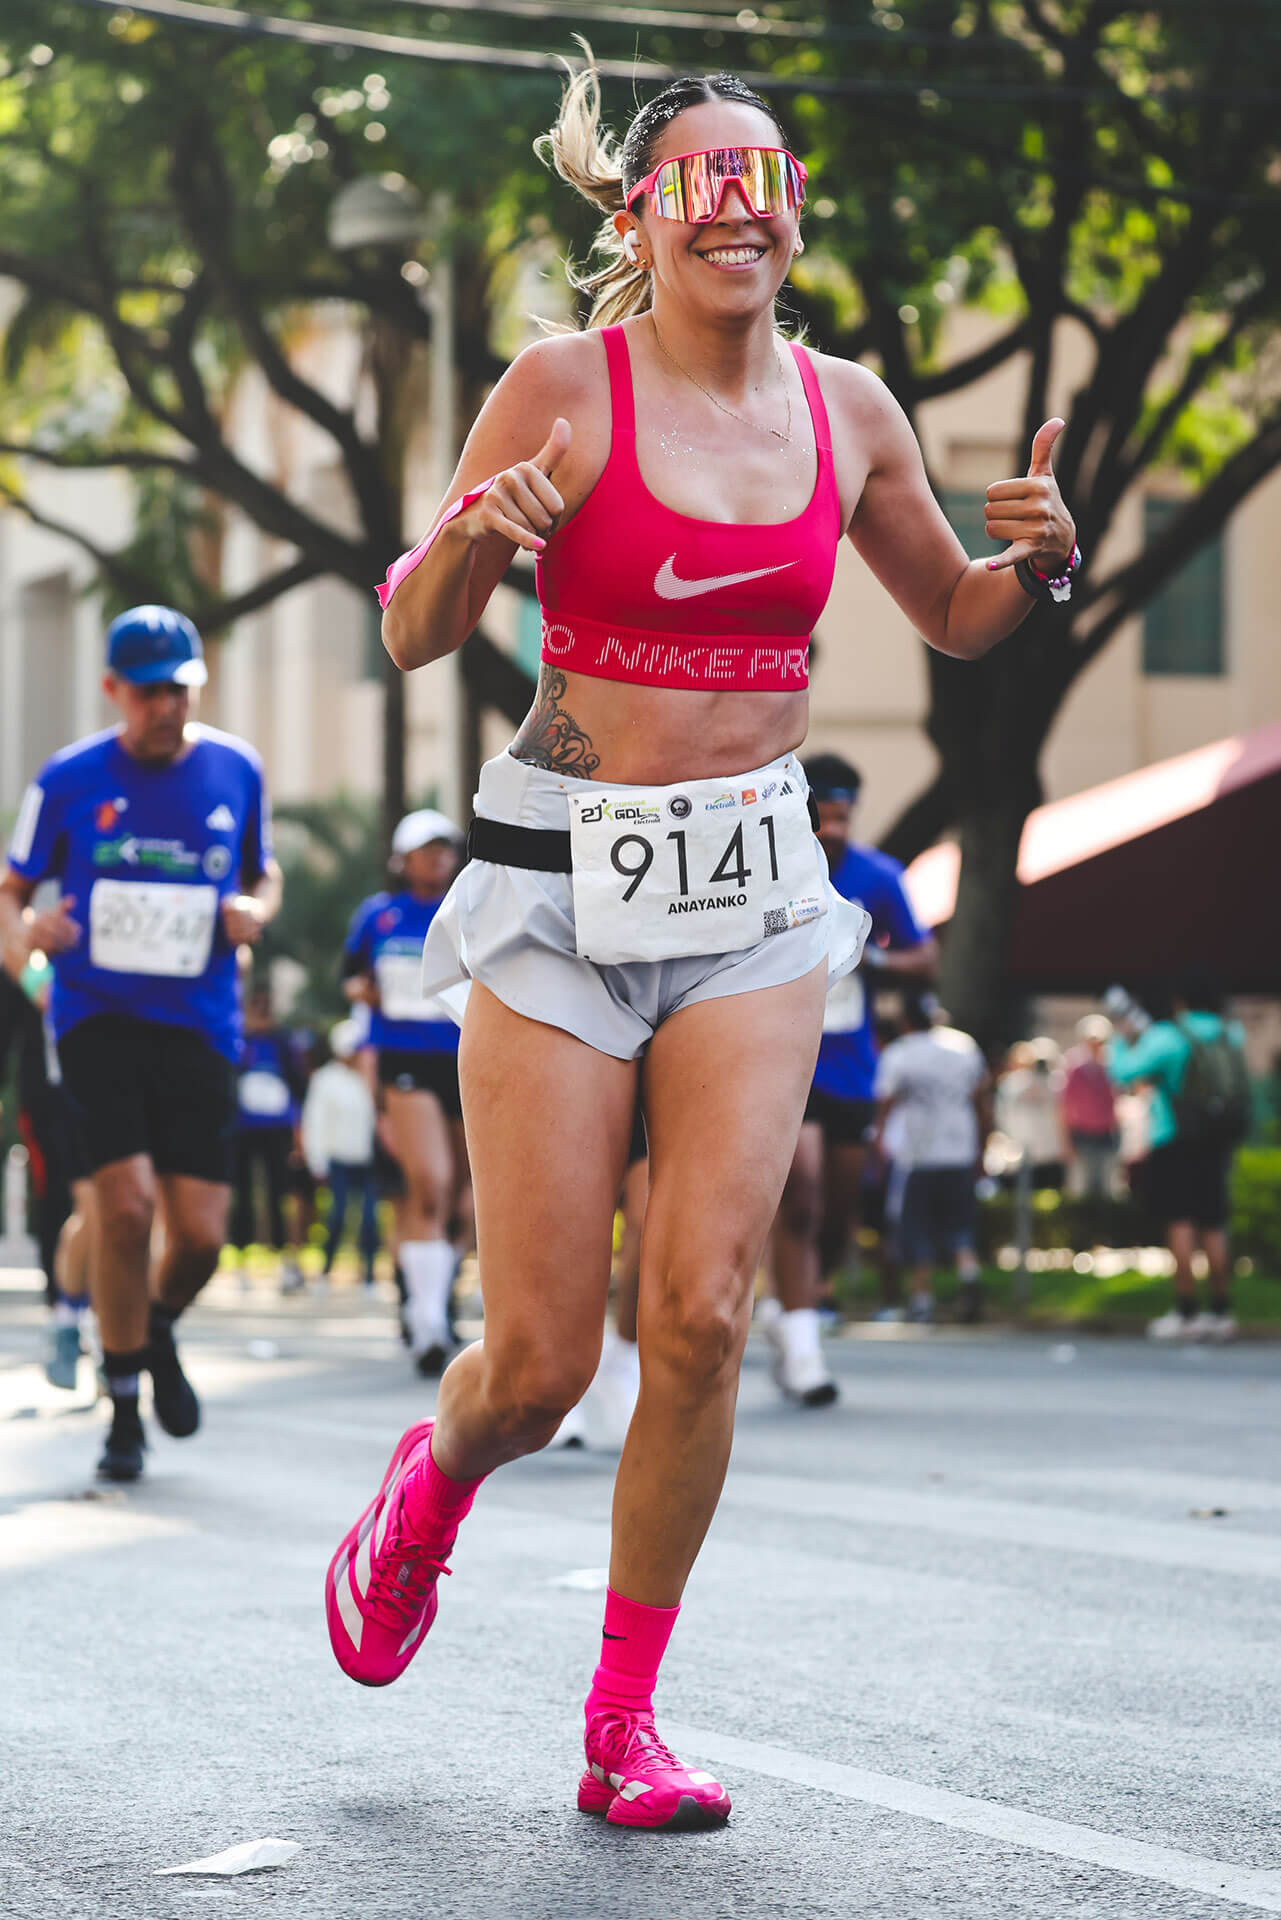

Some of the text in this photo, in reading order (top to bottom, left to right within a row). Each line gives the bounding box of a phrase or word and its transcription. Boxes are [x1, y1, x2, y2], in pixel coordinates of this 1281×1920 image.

[595, 637, 744, 678] NIKE
[615, 808, 642, 820] GDL
[610, 815, 778, 903] 9141
[668, 893, 748, 915] ANAYANKO
